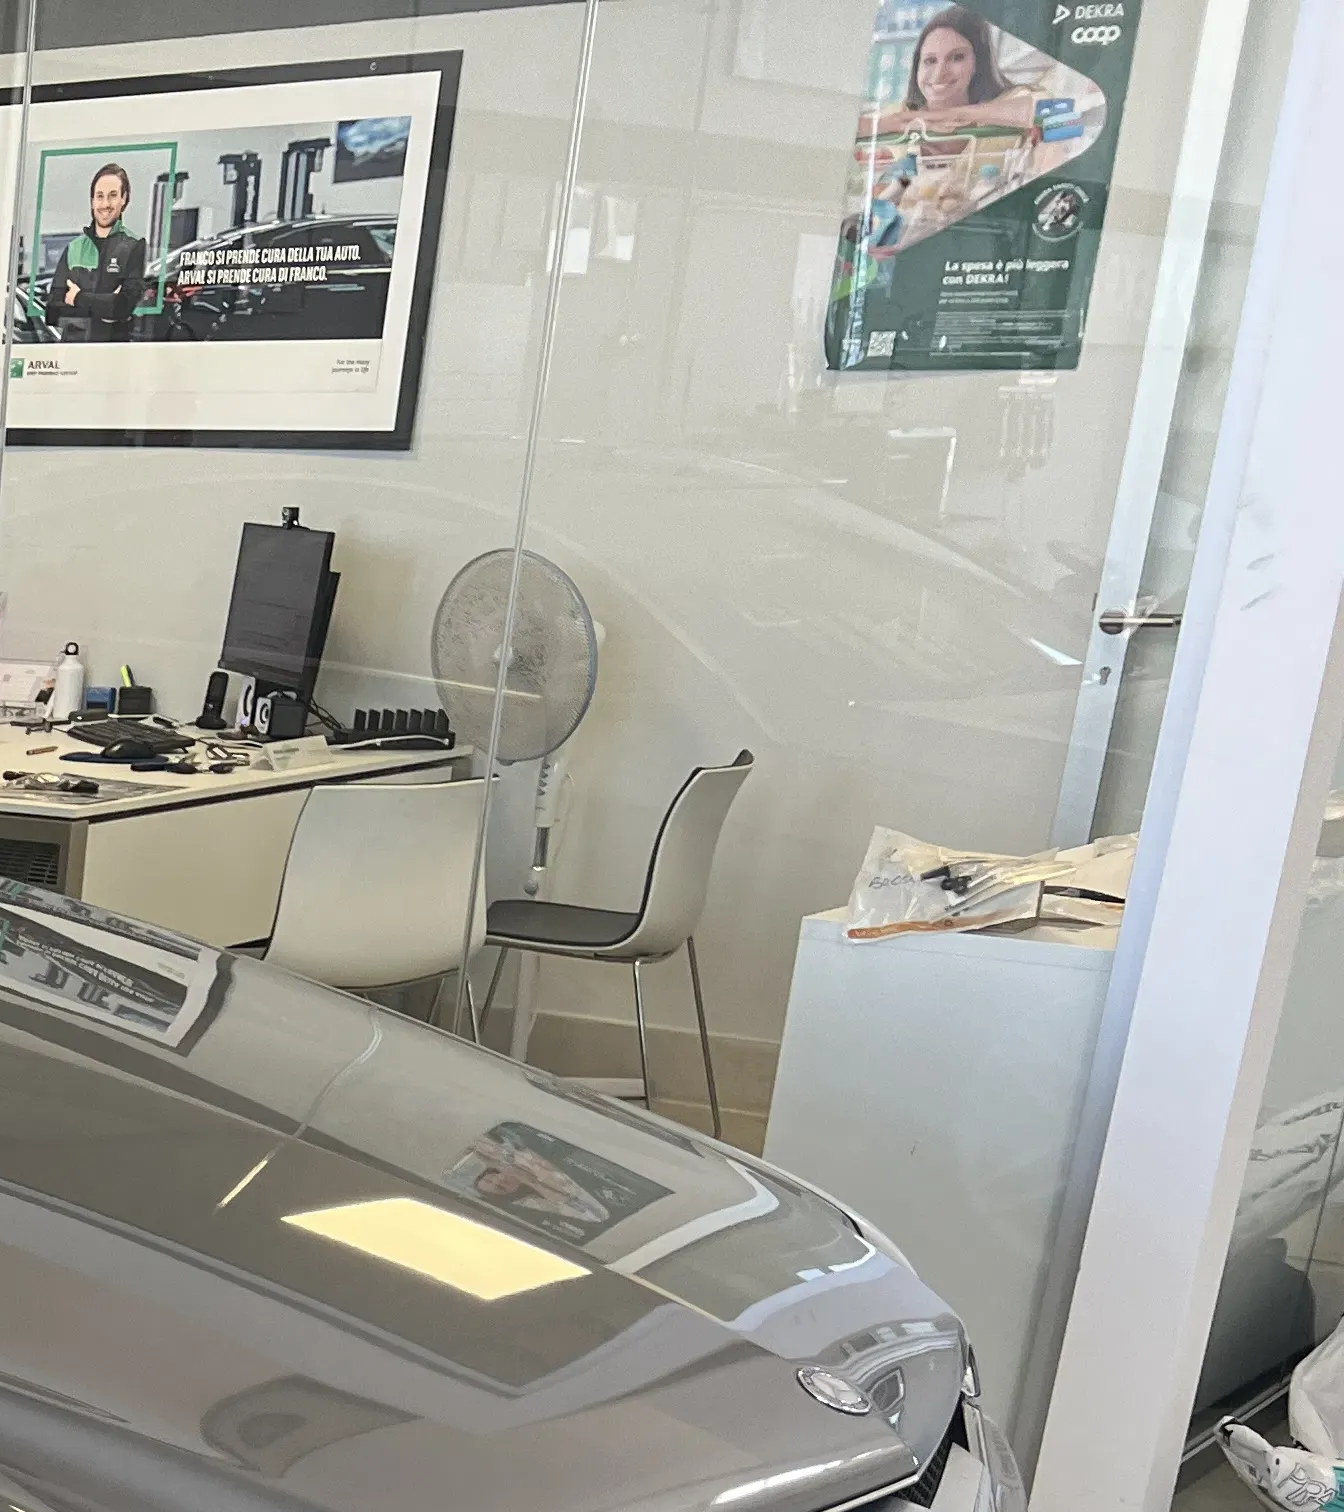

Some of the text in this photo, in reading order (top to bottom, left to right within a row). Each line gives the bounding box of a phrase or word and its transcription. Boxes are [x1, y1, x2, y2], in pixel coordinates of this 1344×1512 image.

[1075, 3, 1124, 19] DEKRA
[179, 245, 361, 266] FRANCO SI PRENDE CURA DELLA TUA AUTO.
[945, 260, 959, 271] La
[962, 261, 993, 272] spesa
[177, 270, 206, 286] ARVAL
[206, 270, 216, 285] SI
[217, 268, 252, 285] PRENDE
[252, 267, 277, 283] CURA
[278, 267, 288, 282] DI
[965, 273, 1010, 285] DEKRA!
[27, 360, 61, 370] ARVAL
